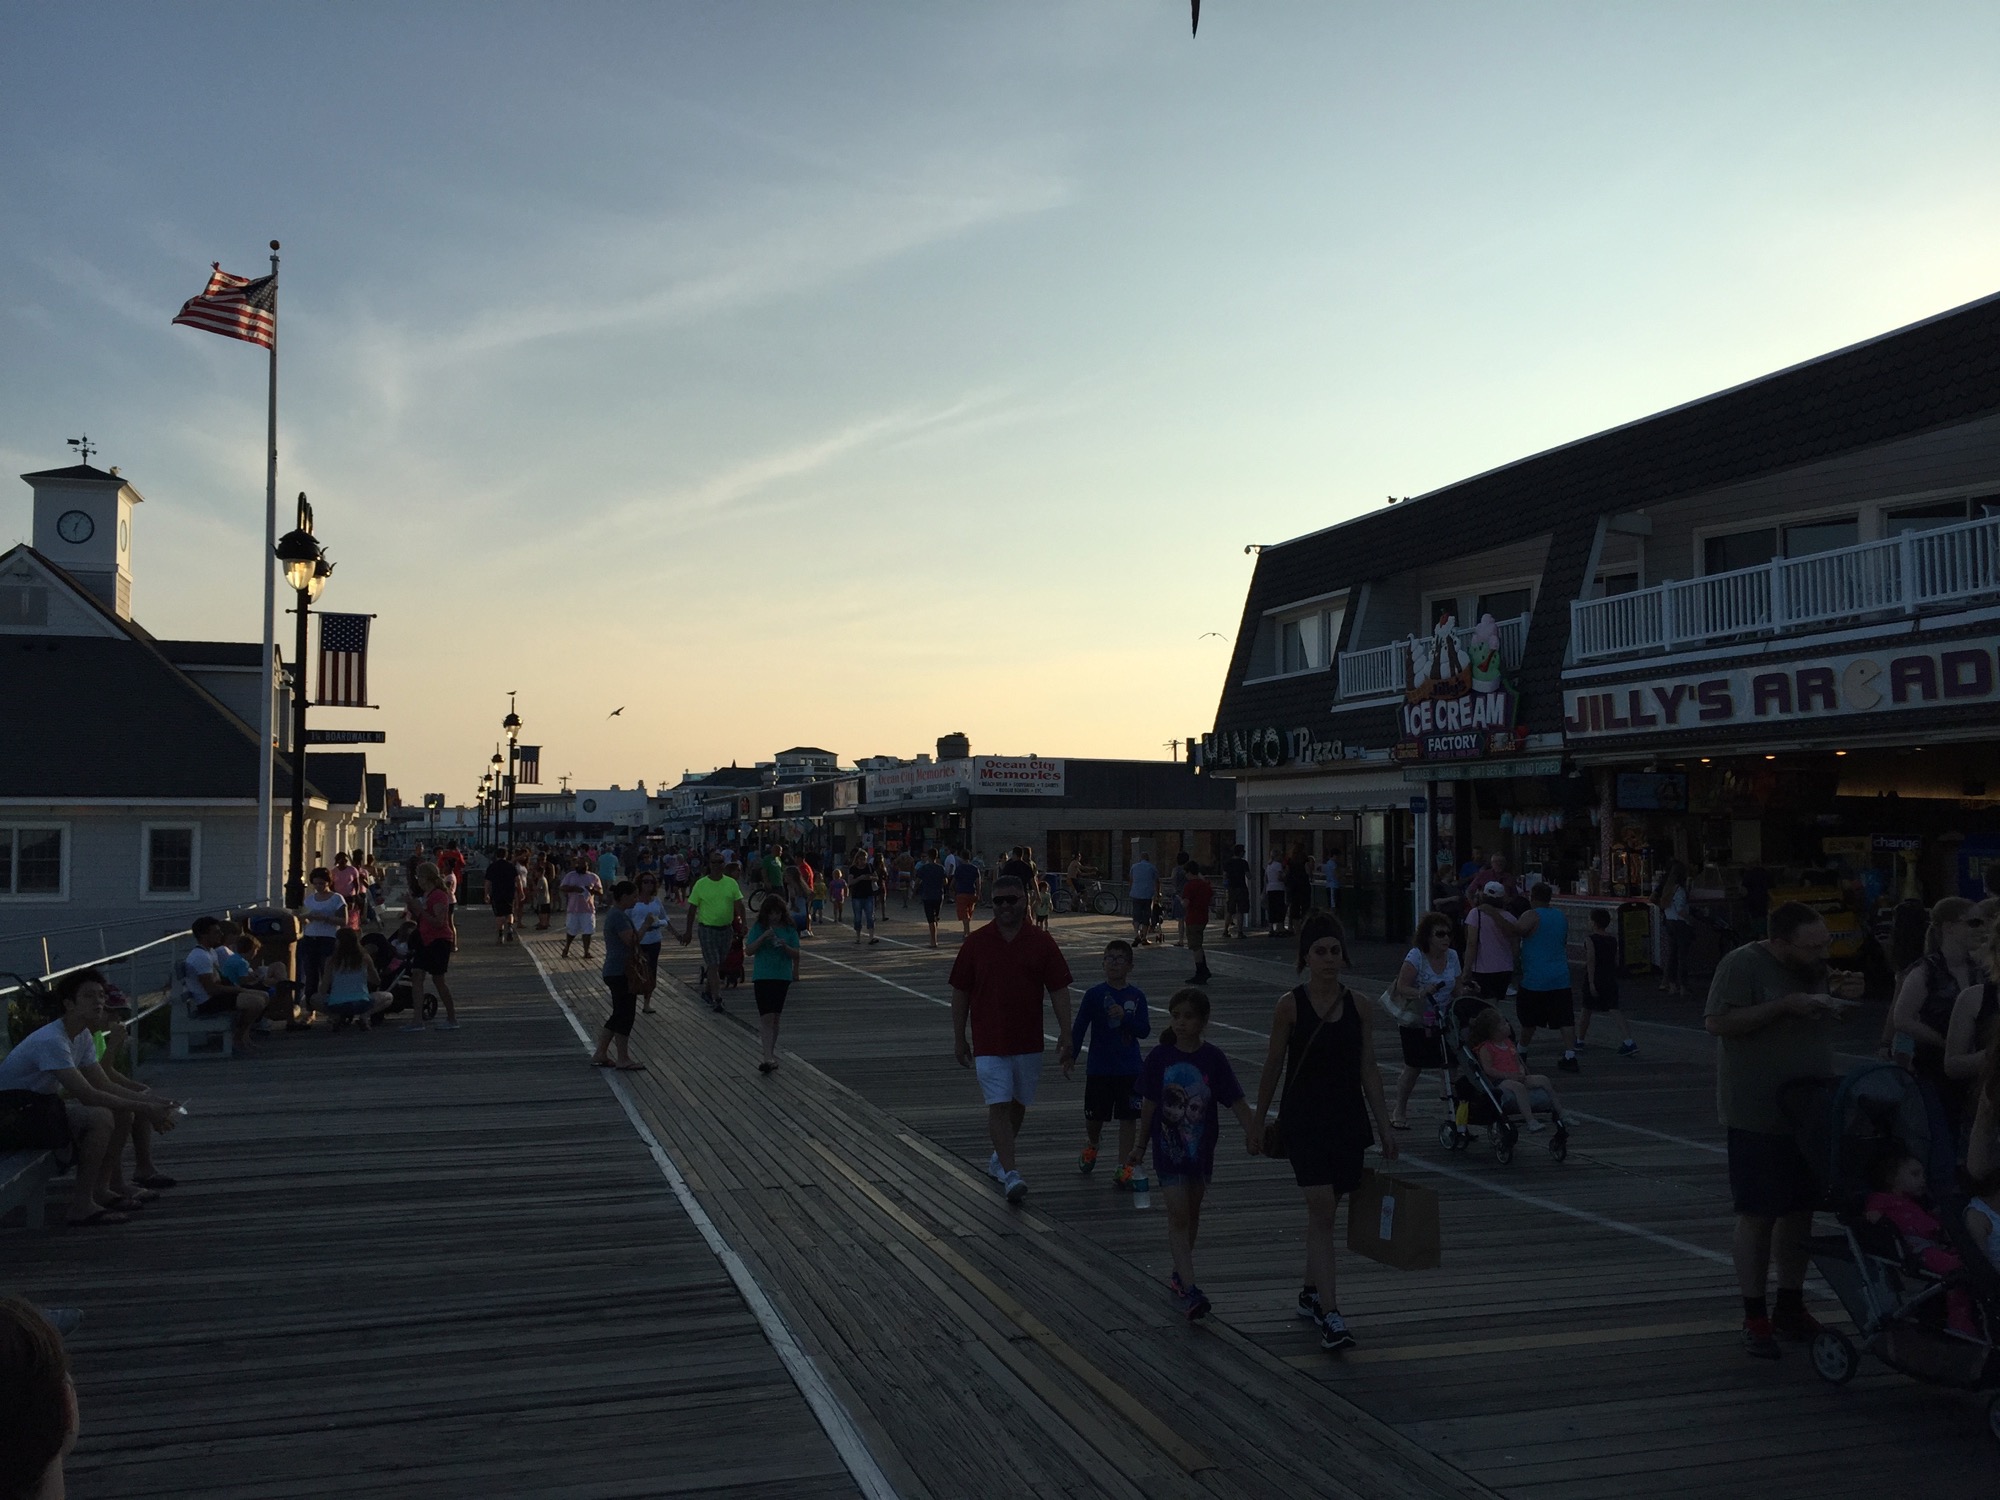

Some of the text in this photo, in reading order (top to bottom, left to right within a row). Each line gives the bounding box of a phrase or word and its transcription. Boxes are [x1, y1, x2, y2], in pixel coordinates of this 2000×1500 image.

[1566, 646, 2000, 734] JILLY'S ARCAD
[1404, 693, 1505, 736] ICE CREAM
[325, 731, 372, 742] BOARDWALK
[1427, 734, 1477, 752] FACTORY
[985, 760, 1056, 771] Ocean City
[878, 766, 956, 785] Ocean City Memories
[980, 769, 1061, 781] Memories
[1872, 837, 1920, 849] change
